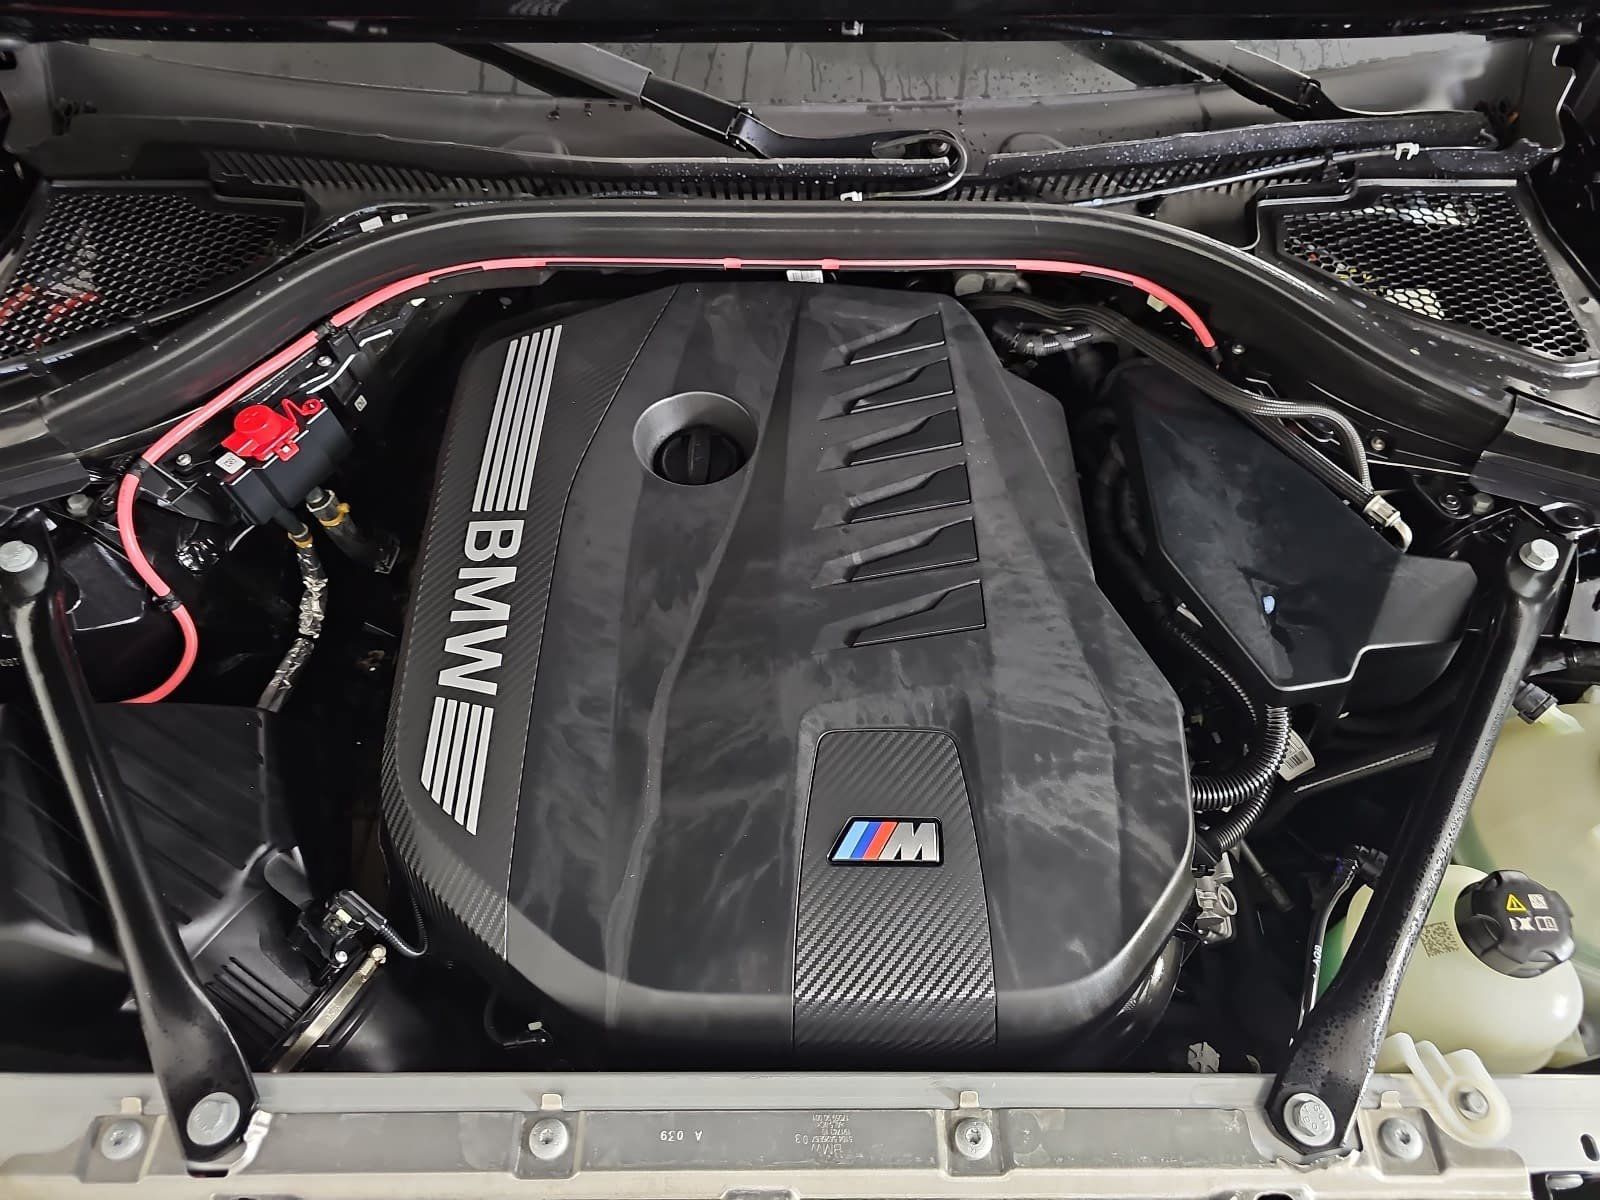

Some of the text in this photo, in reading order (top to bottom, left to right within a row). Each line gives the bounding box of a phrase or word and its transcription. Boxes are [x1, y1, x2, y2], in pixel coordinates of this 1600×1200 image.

[438, 519, 525, 696] BMW
[878, 822, 940, 862] M
[660, 1130, 703, 1142] A 039
